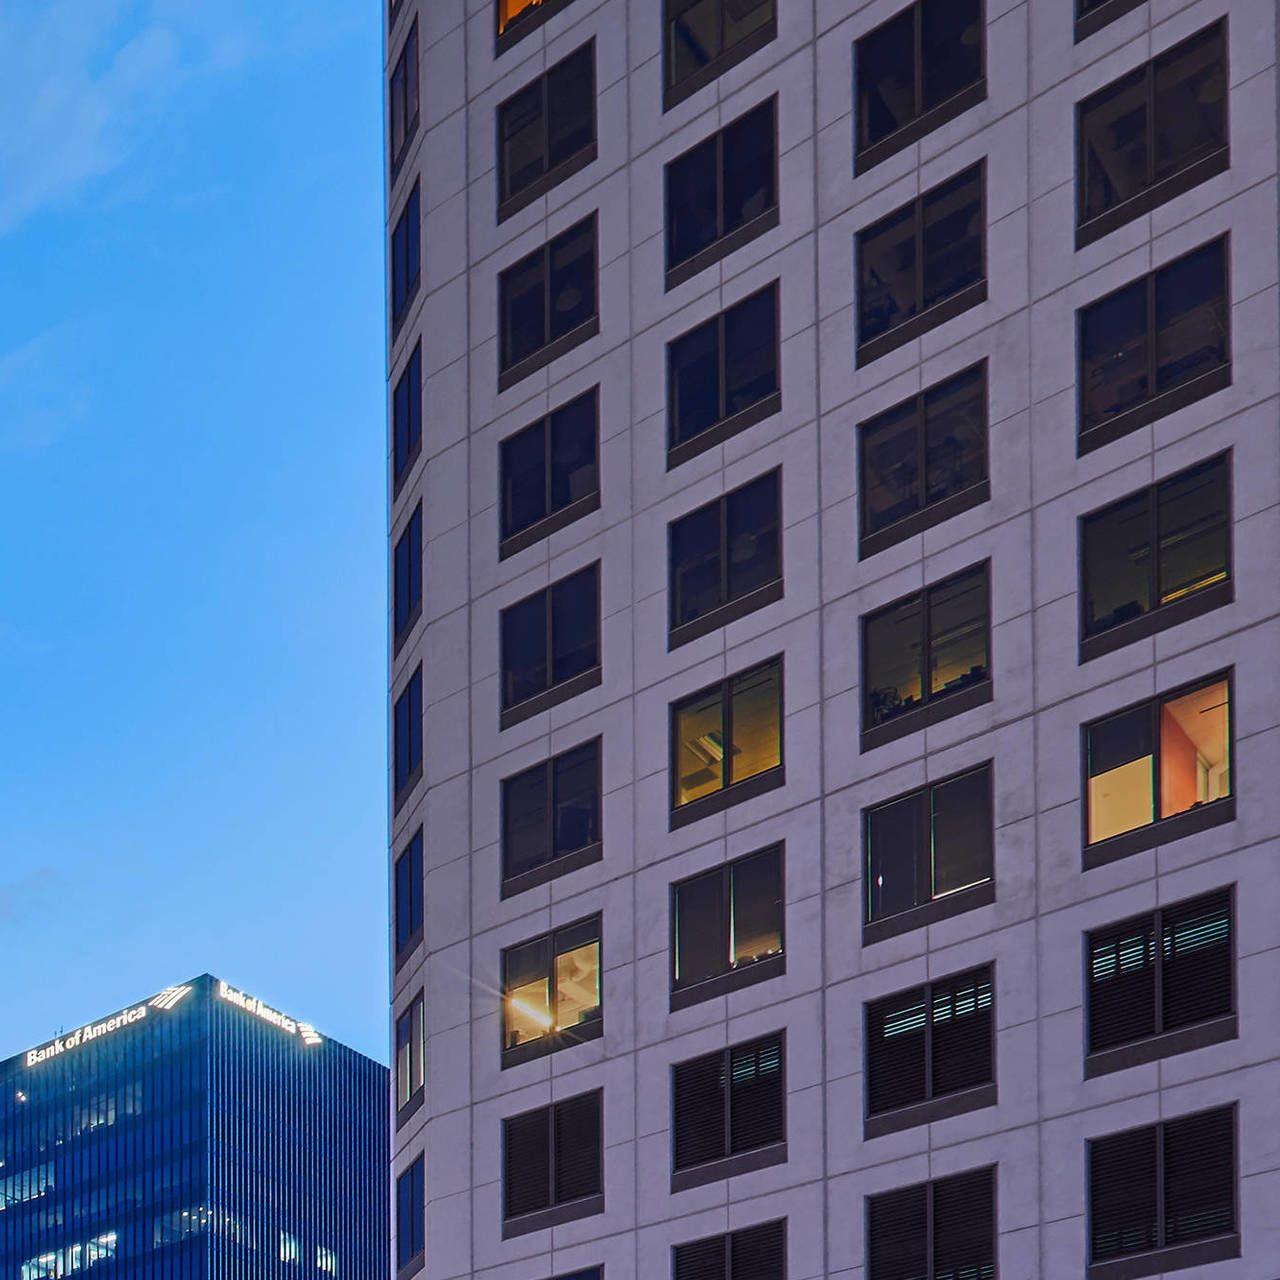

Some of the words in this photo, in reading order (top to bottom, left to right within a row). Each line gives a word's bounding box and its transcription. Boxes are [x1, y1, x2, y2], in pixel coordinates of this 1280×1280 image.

[26, 1040, 65, 1067] Bank
[65, 1028, 82, 1049] of
[82, 1005, 146, 1044] America
[220, 980, 246, 1008] Bank
[256, 1000, 296, 1034] America
